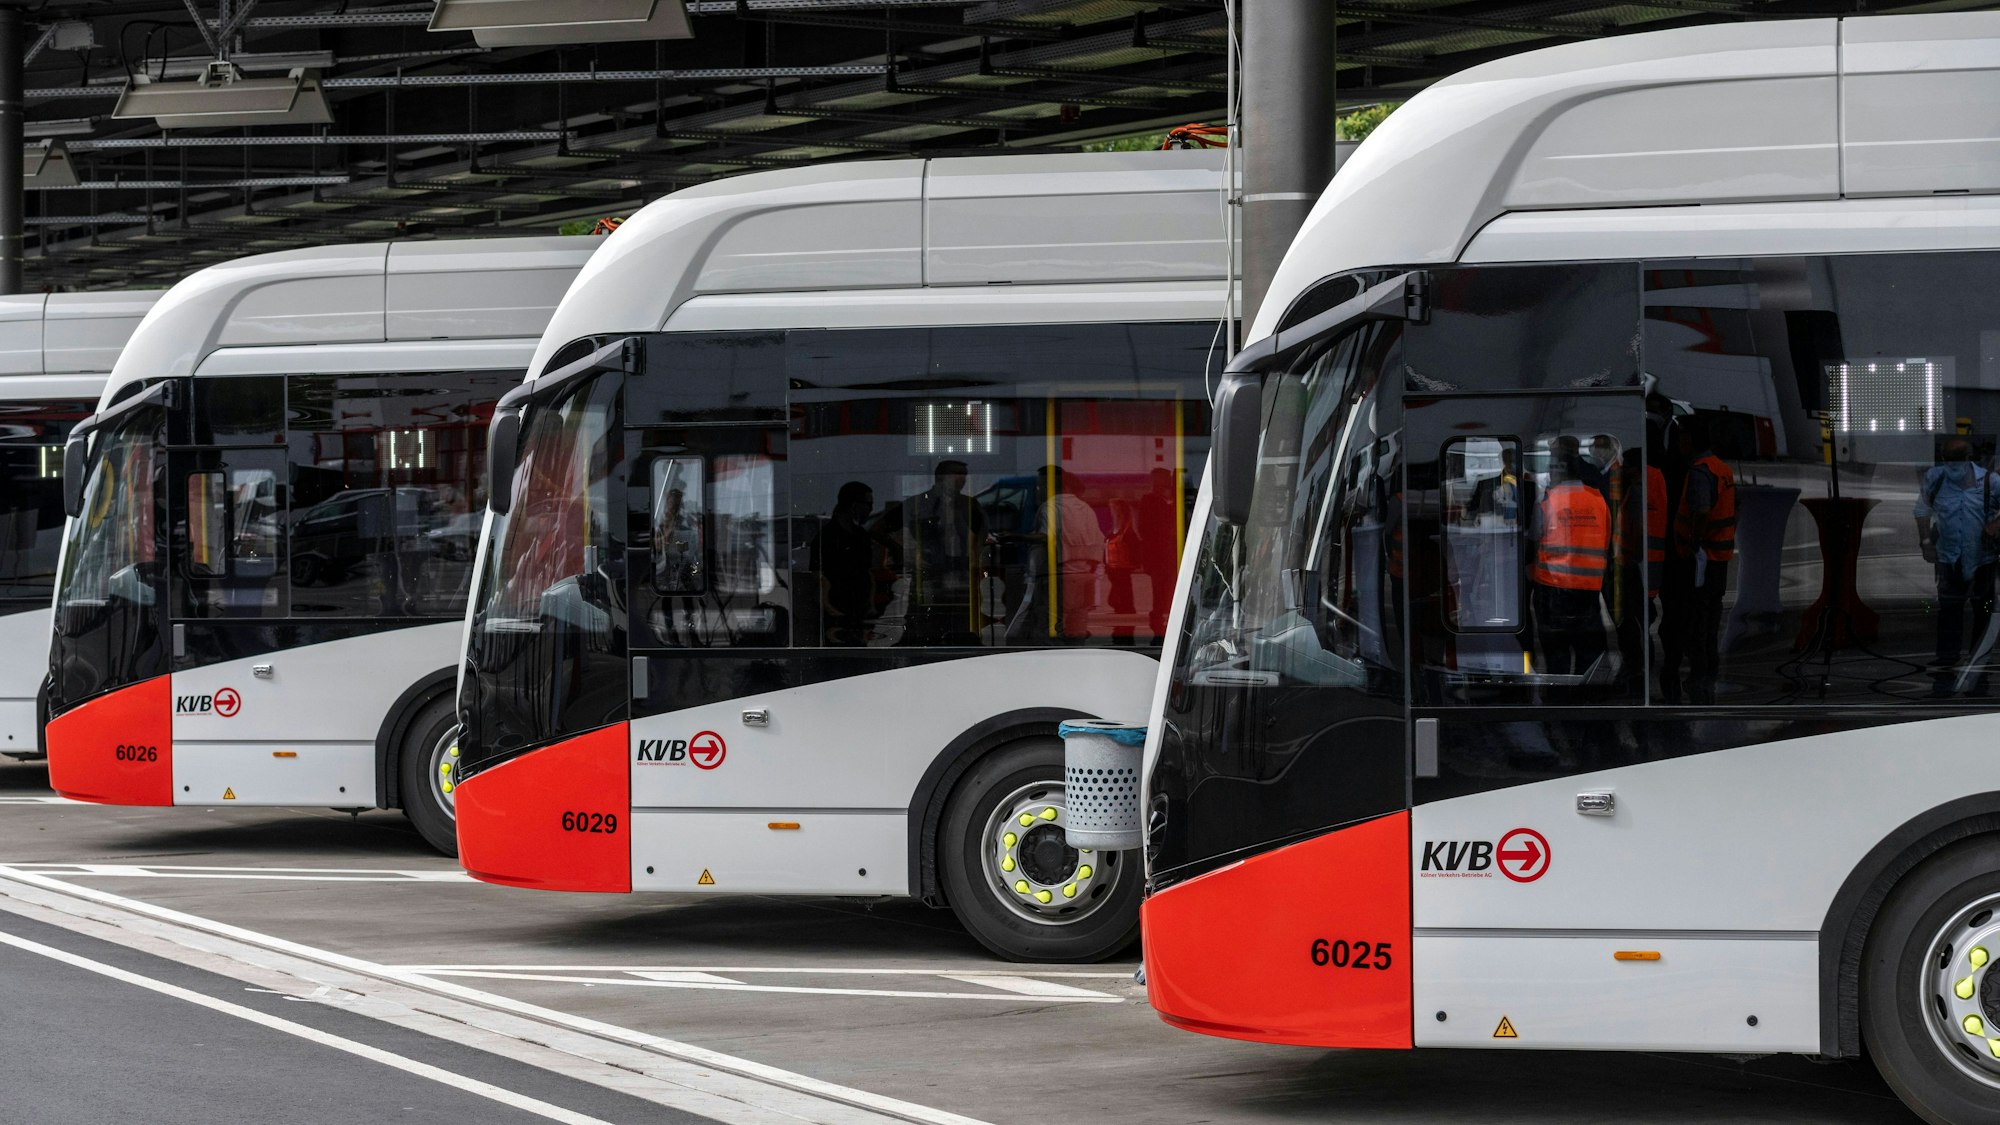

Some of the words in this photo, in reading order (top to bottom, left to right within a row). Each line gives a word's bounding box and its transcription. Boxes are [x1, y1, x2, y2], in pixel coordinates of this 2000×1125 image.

[176, 695, 212, 712] KVB
[116, 745, 157, 762] 6026
[637, 739, 687, 761] KVB
[562, 811, 617, 834] 6029
[1421, 841, 1494, 871] KVB
[1311, 938, 1392, 971] 6025
